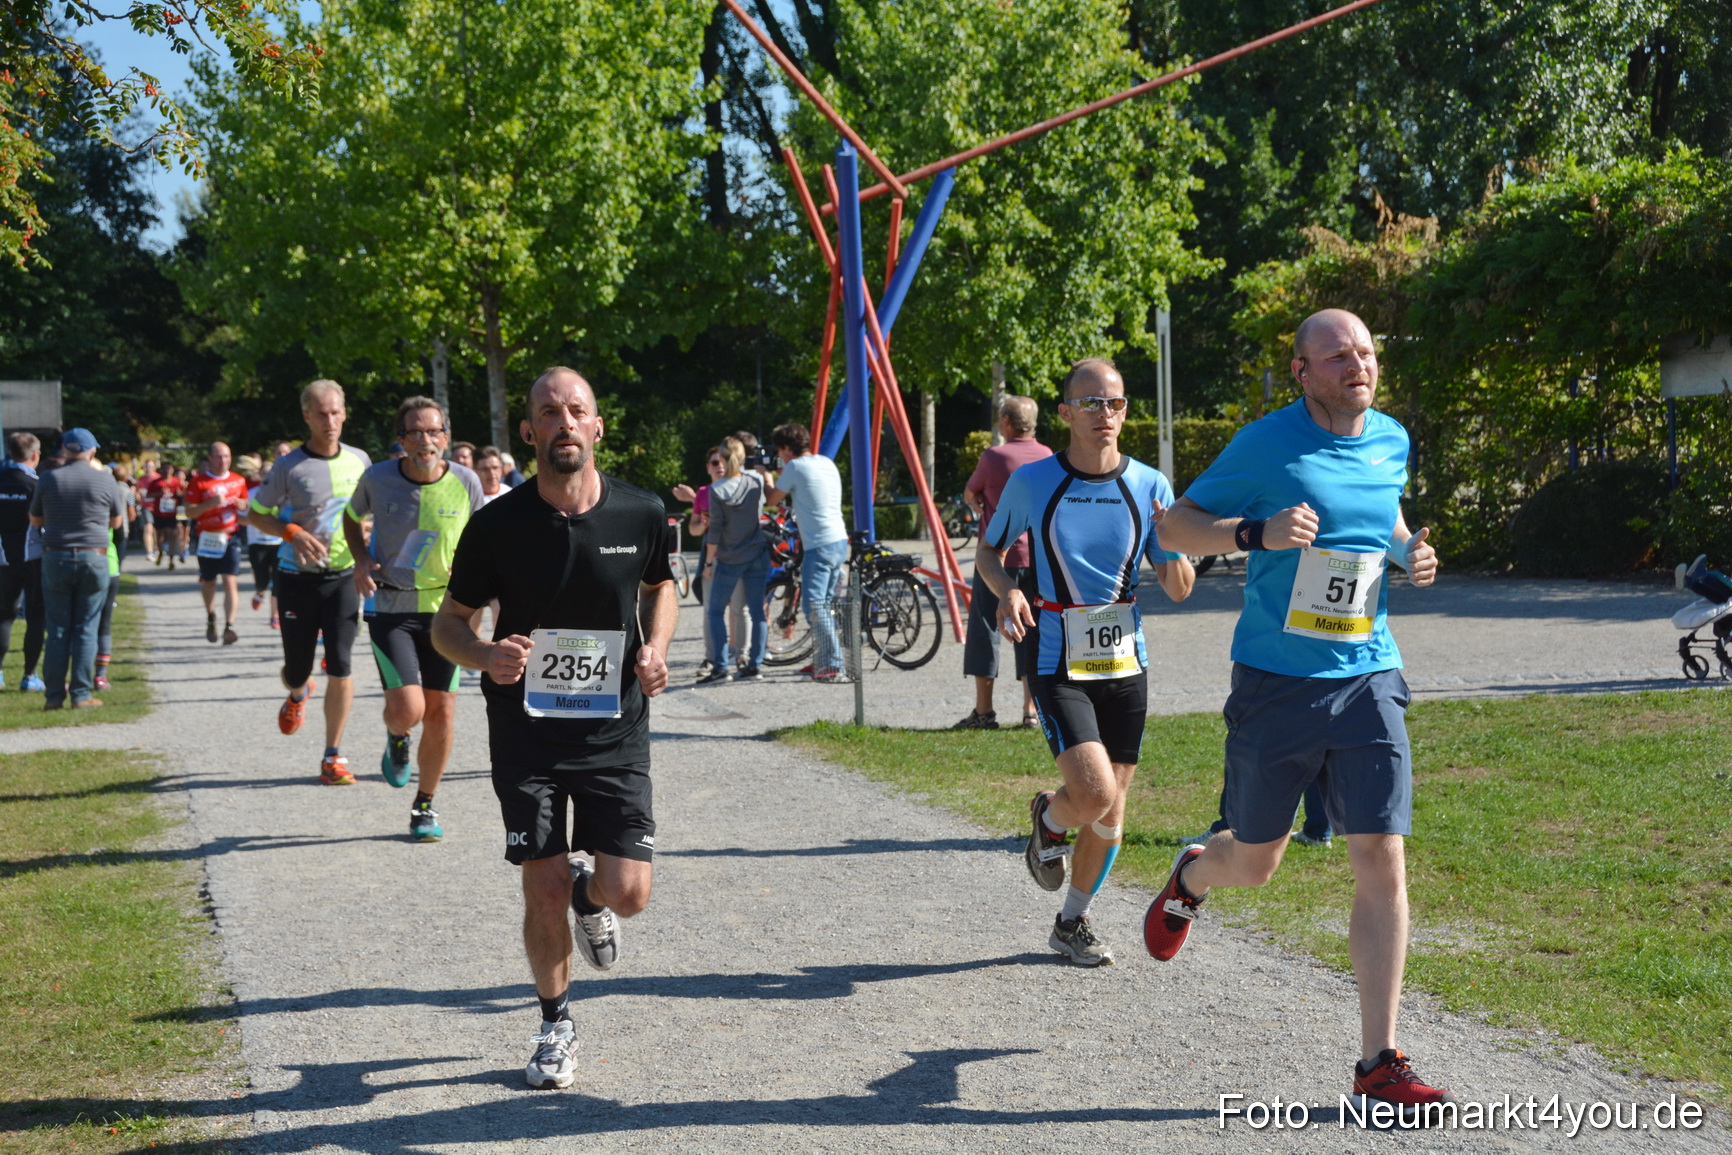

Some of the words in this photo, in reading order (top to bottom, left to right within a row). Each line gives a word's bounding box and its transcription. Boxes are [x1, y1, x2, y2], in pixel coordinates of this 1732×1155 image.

[599, 546, 616, 554] Thule
[617, 545, 634, 554] Group
[1328, 557, 1367, 571] BOCK
[1326, 576, 1358, 605] 51
[1311, 604, 1332, 613] PARTL
[1087, 611, 1118, 621] BOCK
[1315, 617, 1355, 631] Markus
[557, 637, 598, 648] BOCK
[1085, 625, 1122, 649] 160
[541, 653, 608, 682] 2354
[1086, 661, 1124, 672] Christian
[555, 696, 591, 708] Marco
